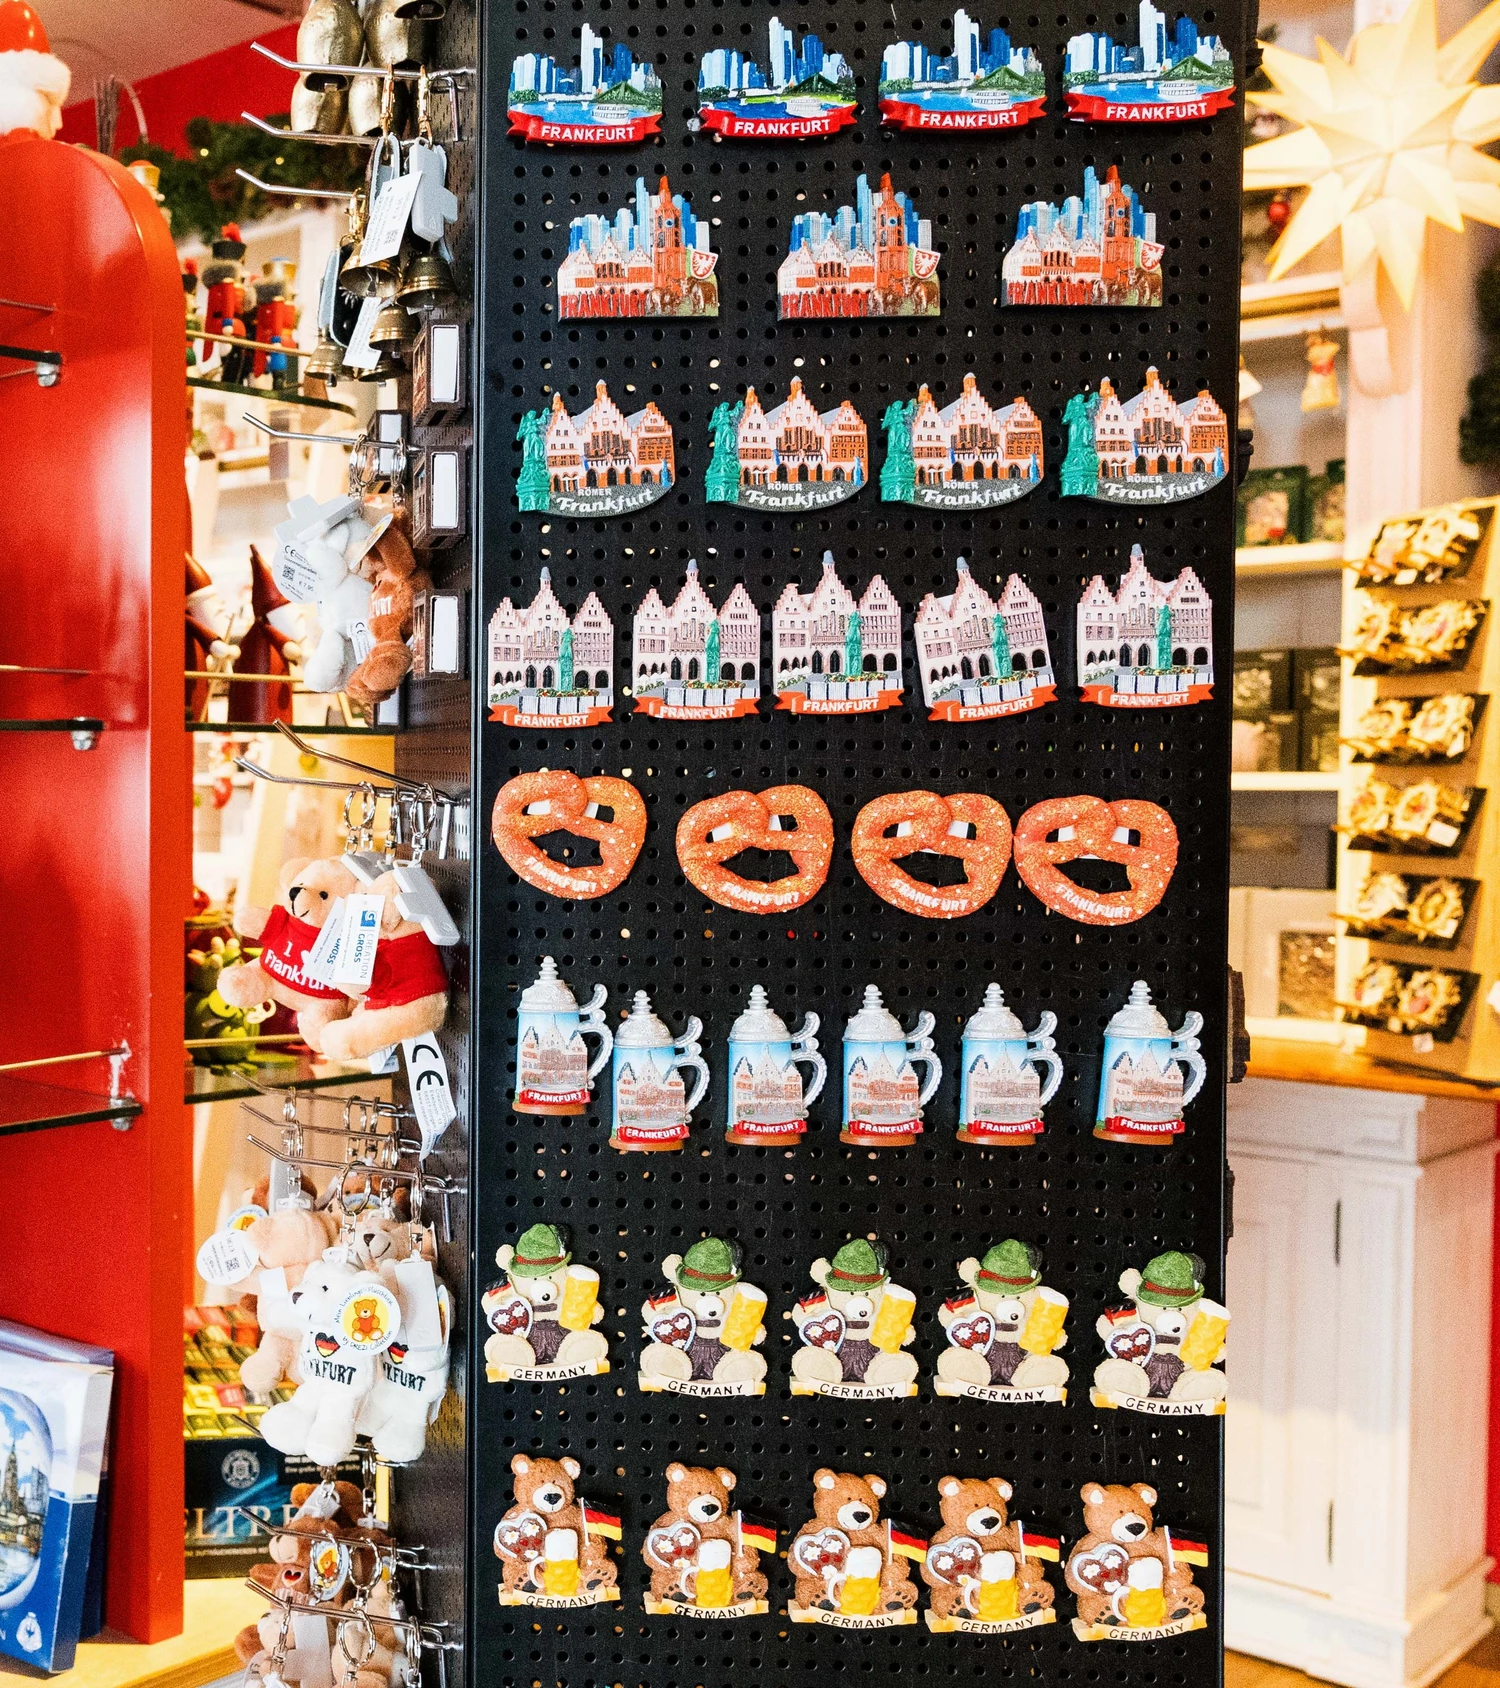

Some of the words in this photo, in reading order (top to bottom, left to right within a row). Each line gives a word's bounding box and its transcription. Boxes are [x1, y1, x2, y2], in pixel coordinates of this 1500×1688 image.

[920, 110, 1019, 127] FRANKFURT
[1106, 102, 1207, 120] FRANKFURT
[541, 126, 635, 141] FRANKFURT
[734, 119, 830, 134] FRANKFURT
[560, 293, 651, 317] FRANKFURT
[781, 293, 871, 318] FRANKFURT
[767, 481, 802, 492] RÖMER
[943, 480, 978, 491] RÖMER
[1126, 475, 1163, 485] RÖMER
[577, 487, 612, 497] RÖMER
[745, 485, 845, 508] Frankfurt
[921, 482, 1021, 506] Frankfurt
[1104, 477, 1207, 501] Frankfurt
[556, 488, 654, 512] Frankfurt
[803, 698, 880, 713] FRANKFURT
[959, 696, 1034, 720] FRANKFURT
[1110, 693, 1190, 707] FRANKFURT
[514, 713, 589, 728] FRANKFURT
[659, 706, 735, 720] FRANKFURT
[524, 857, 597, 893] FRANKFURT
[721, 882, 800, 905] FRANKFURT
[890, 878, 969, 911] FRANKFURT
[1055, 884, 1133, 919] FRANKFURT
[354, 933, 366, 963] GROSS
[528, 1090, 583, 1104] FRANKFURT
[626, 1126, 681, 1140] FRANKFURT
[743, 1120, 800, 1133] FRANKFURT
[859, 1121, 915, 1134] FRANKFURT
[980, 1120, 1037, 1134] FRANKFURT
[1120, 1118, 1178, 1132] FRANKFURT
[513, 1365, 587, 1381] GERMANY
[668, 1380, 744, 1397] GERMANY
[820, 1383, 895, 1399] GERMANY
[966, 1385, 1045, 1401] GERMANY
[1126, 1397, 1204, 1415] GERMANY
[525, 1593, 597, 1609] GERMANY
[674, 1604, 747, 1621] GERMANY
[821, 1613, 895, 1629] GERMANY
[961, 1617, 1034, 1633] GERMANY
[1109, 1623, 1184, 1640] GERMANY
